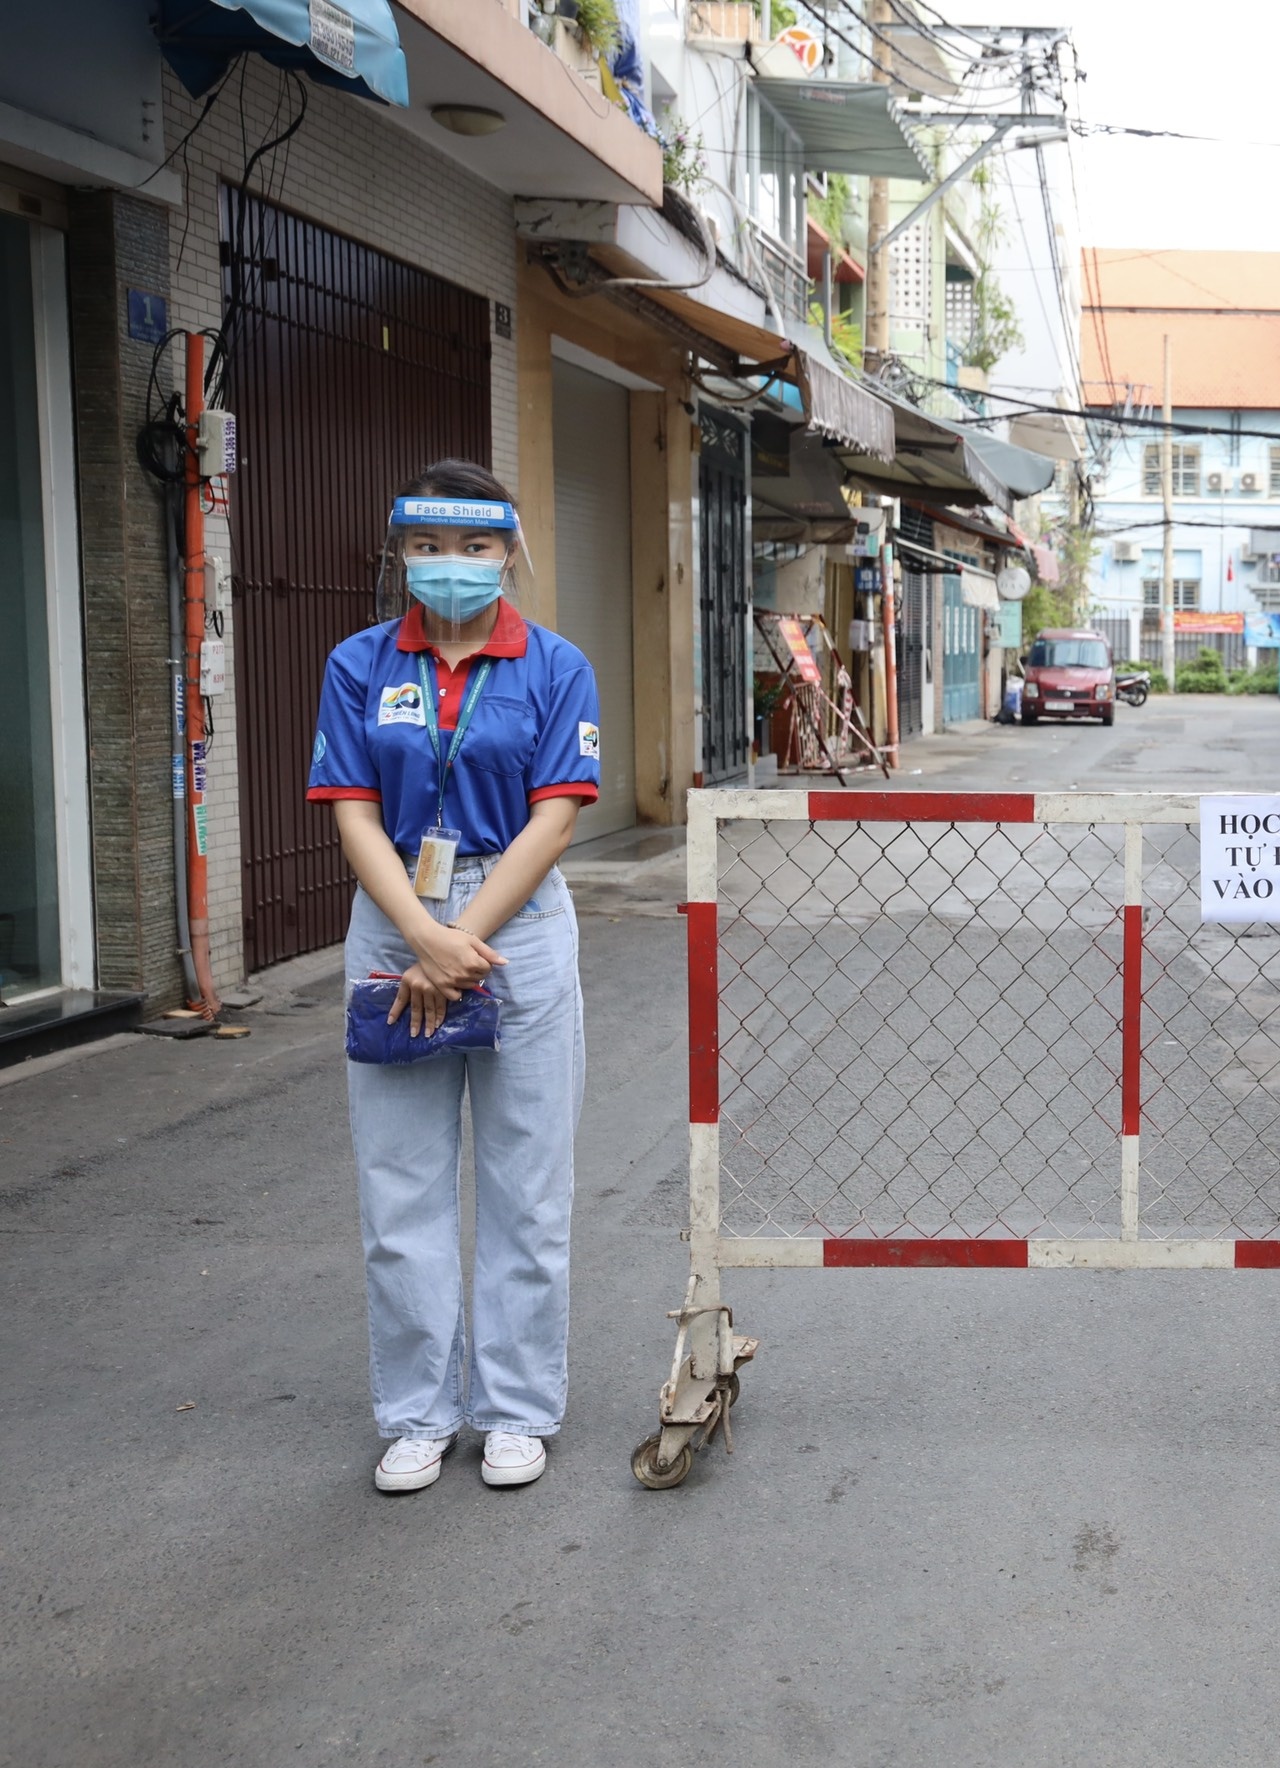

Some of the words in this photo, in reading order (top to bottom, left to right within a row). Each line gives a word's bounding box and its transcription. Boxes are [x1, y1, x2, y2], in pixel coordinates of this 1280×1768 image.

[416, 504, 446, 515] Face
[453, 506, 492, 517] Shield
[421, 516, 449, 524] Protective
[1219, 813, 1280, 839] HỌC
[1225, 843, 1267, 872] TỰ
[1212, 873, 1273, 899] VÀO
